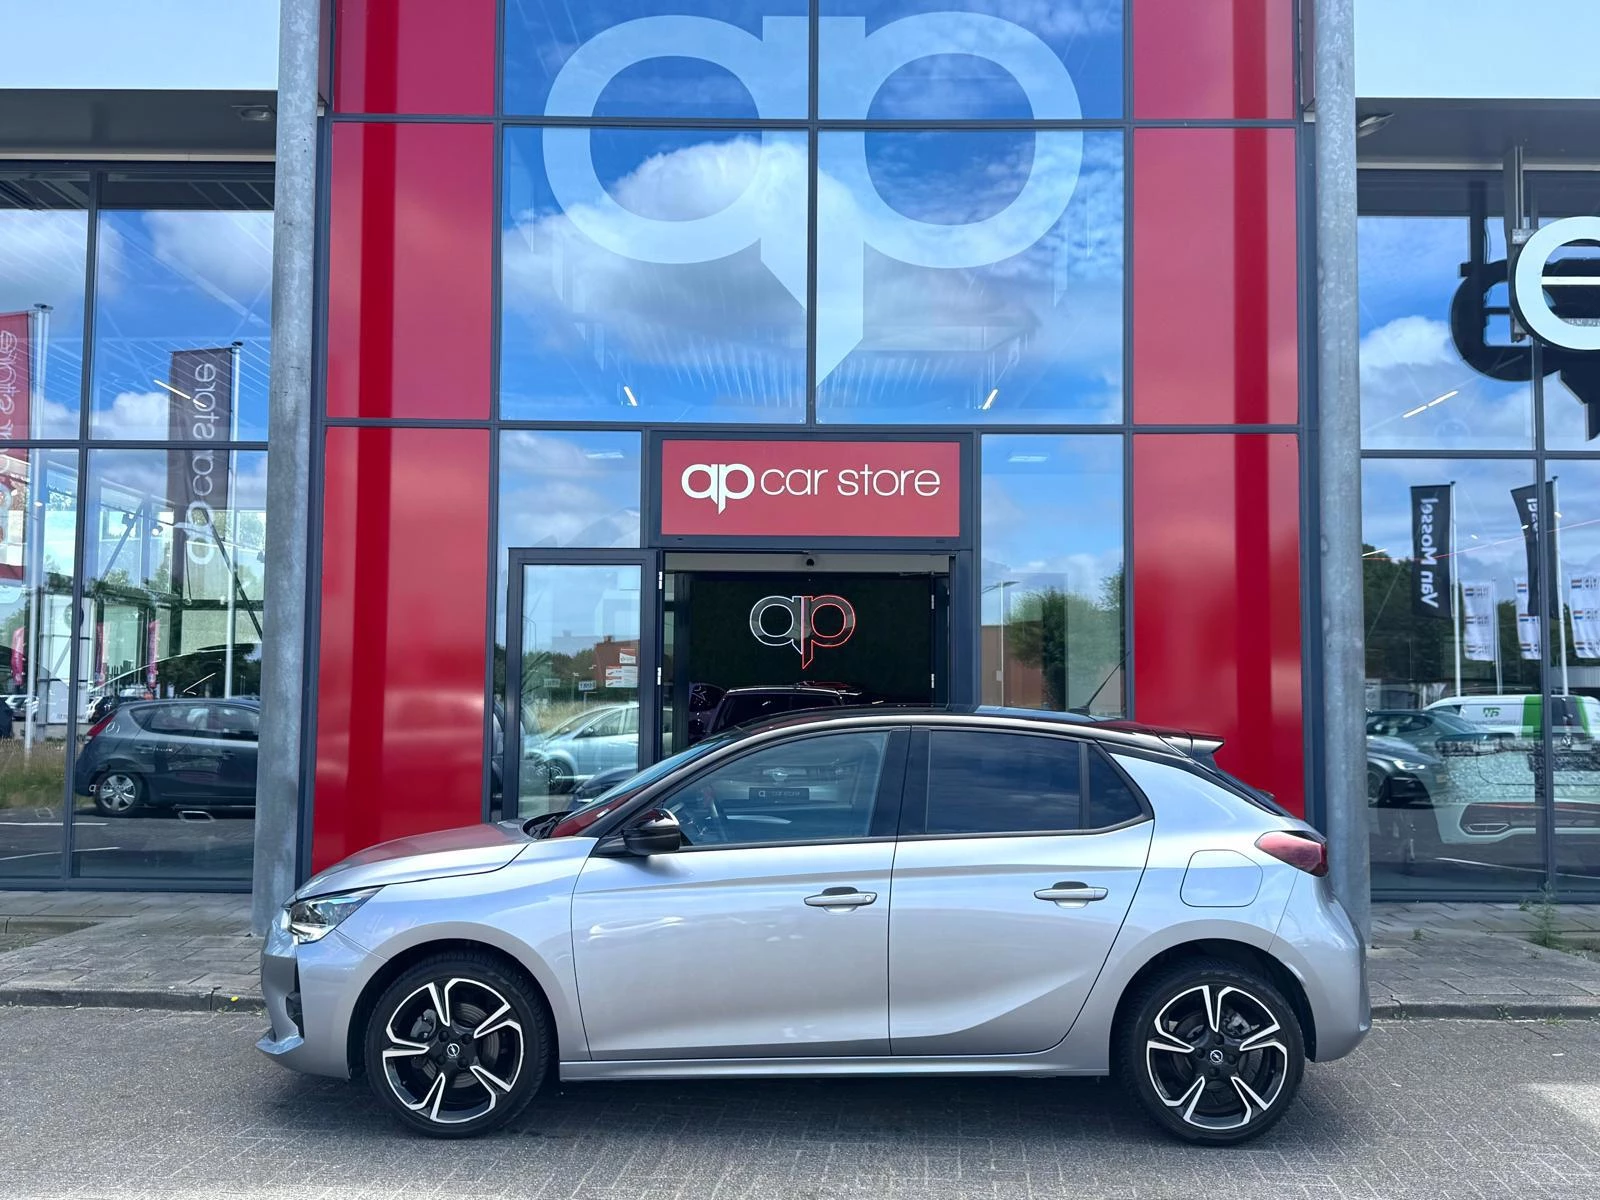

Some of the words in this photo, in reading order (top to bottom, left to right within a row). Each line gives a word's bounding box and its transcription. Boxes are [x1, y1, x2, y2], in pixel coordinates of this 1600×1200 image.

[543, 12, 1082, 387] ap
[681, 463, 755, 515] ap
[760, 468, 829, 496] car
[837, 463, 941, 497] store
[749, 594, 856, 669] ap
